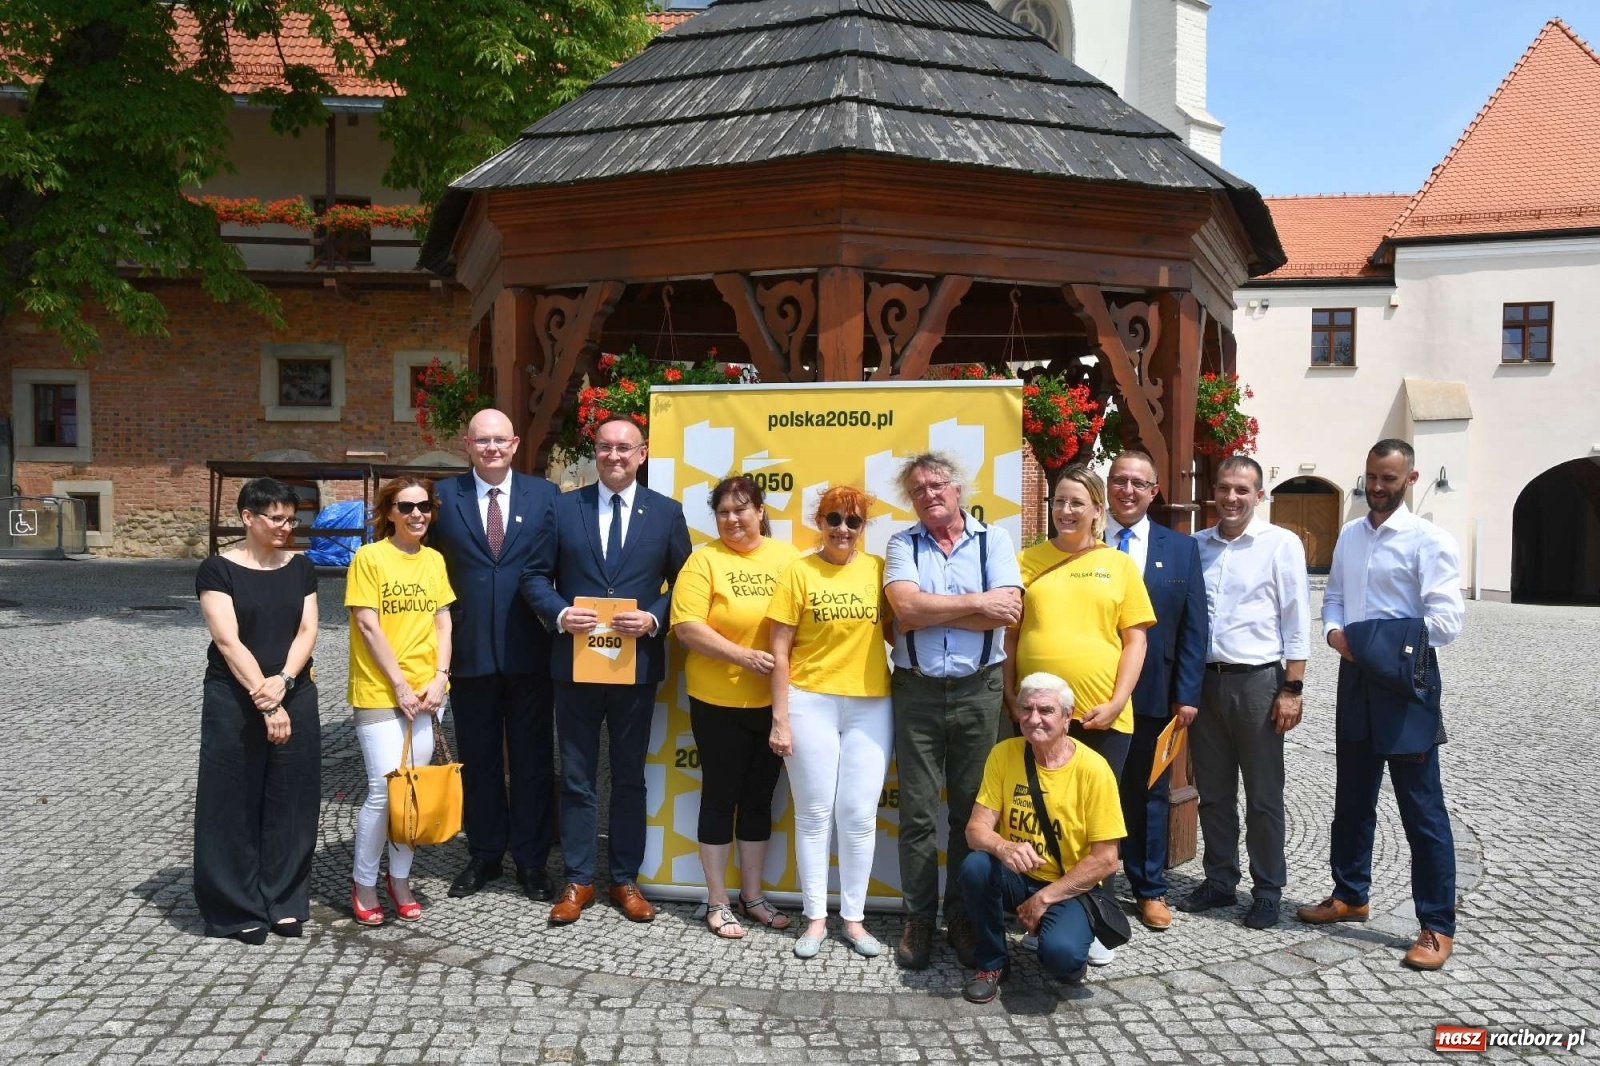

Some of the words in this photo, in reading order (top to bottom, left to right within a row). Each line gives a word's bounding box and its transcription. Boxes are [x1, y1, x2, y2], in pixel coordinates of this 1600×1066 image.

[768, 410, 893, 431] polska2050.pl
[726, 570, 776, 584] ŻÓŁTA
[382, 581, 426, 598] ŻÓŁTA
[808, 590, 863, 606] ŻÓŁTA
[382, 599, 437, 616] REWOLUCJ
[588, 636, 622, 648] 2050
[675, 749, 700, 768] 20
